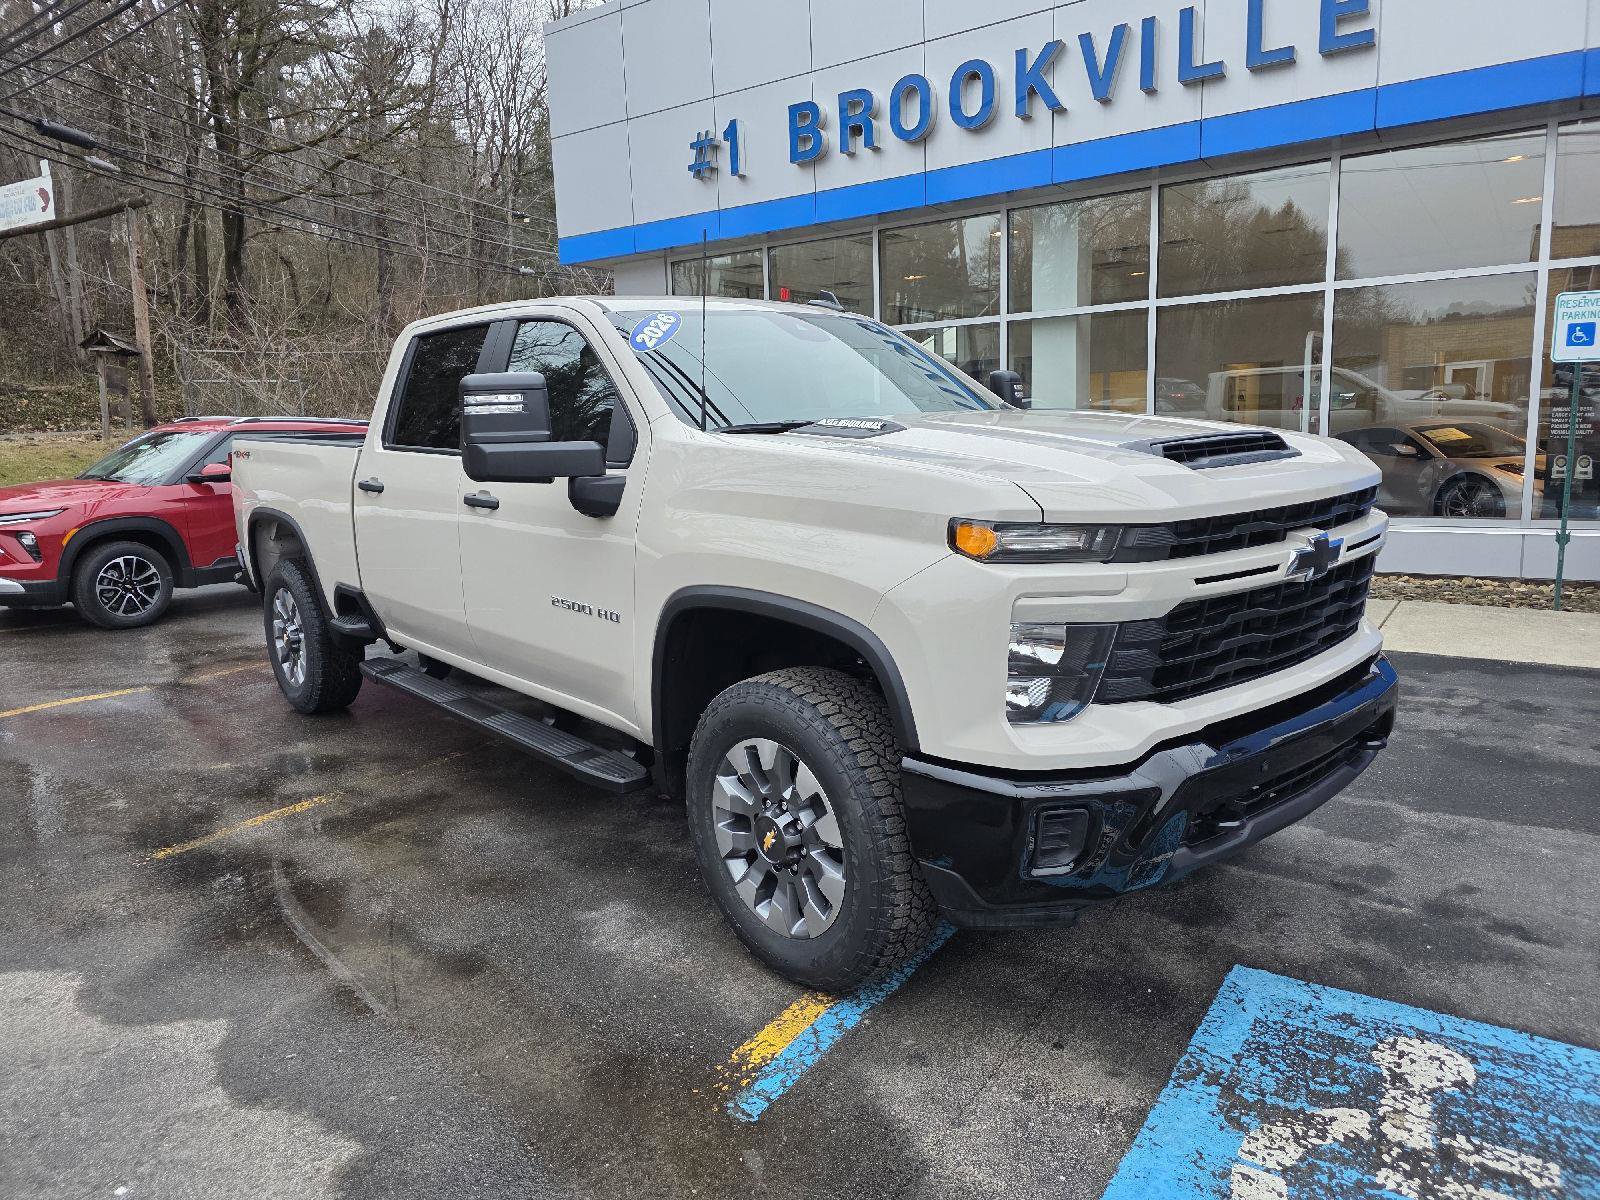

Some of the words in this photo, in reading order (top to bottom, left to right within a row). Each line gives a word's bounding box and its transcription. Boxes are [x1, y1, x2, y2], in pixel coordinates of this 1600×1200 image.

[688, 118, 746, 180] #1
[788, 0, 1376, 165] BROOKVILLE
[1560, 298, 1600, 308] RESERVE
[551, 595, 593, 616] 2500
[598, 607, 621, 623] HD
